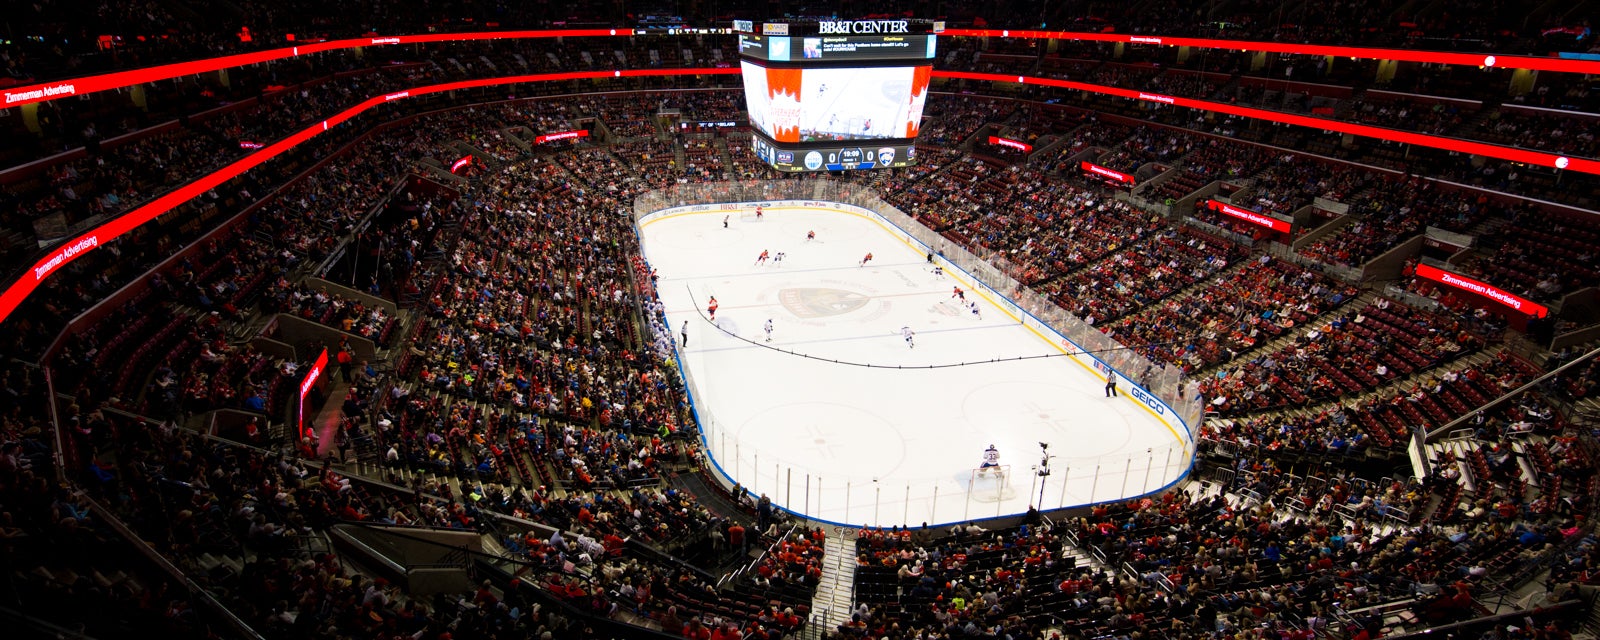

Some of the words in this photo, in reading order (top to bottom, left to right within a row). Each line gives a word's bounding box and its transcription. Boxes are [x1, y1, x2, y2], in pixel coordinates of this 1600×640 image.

[818, 20, 852, 33] BB&T
[852, 20, 909, 33] CENTER
[4, 90, 44, 103] Zimmerman
[44, 84, 75, 96] Advertising
[829, 153, 835, 163] 0
[843, 150, 860, 158] 19:09
[867, 151, 873, 161] 0
[35, 253, 64, 280] Zimmerman
[63, 235, 98, 259] Advertising
[1441, 273, 1486, 293] Zimmerman
[1485, 287, 1521, 309] Advertising
[1131, 387, 1164, 415] GEICO
